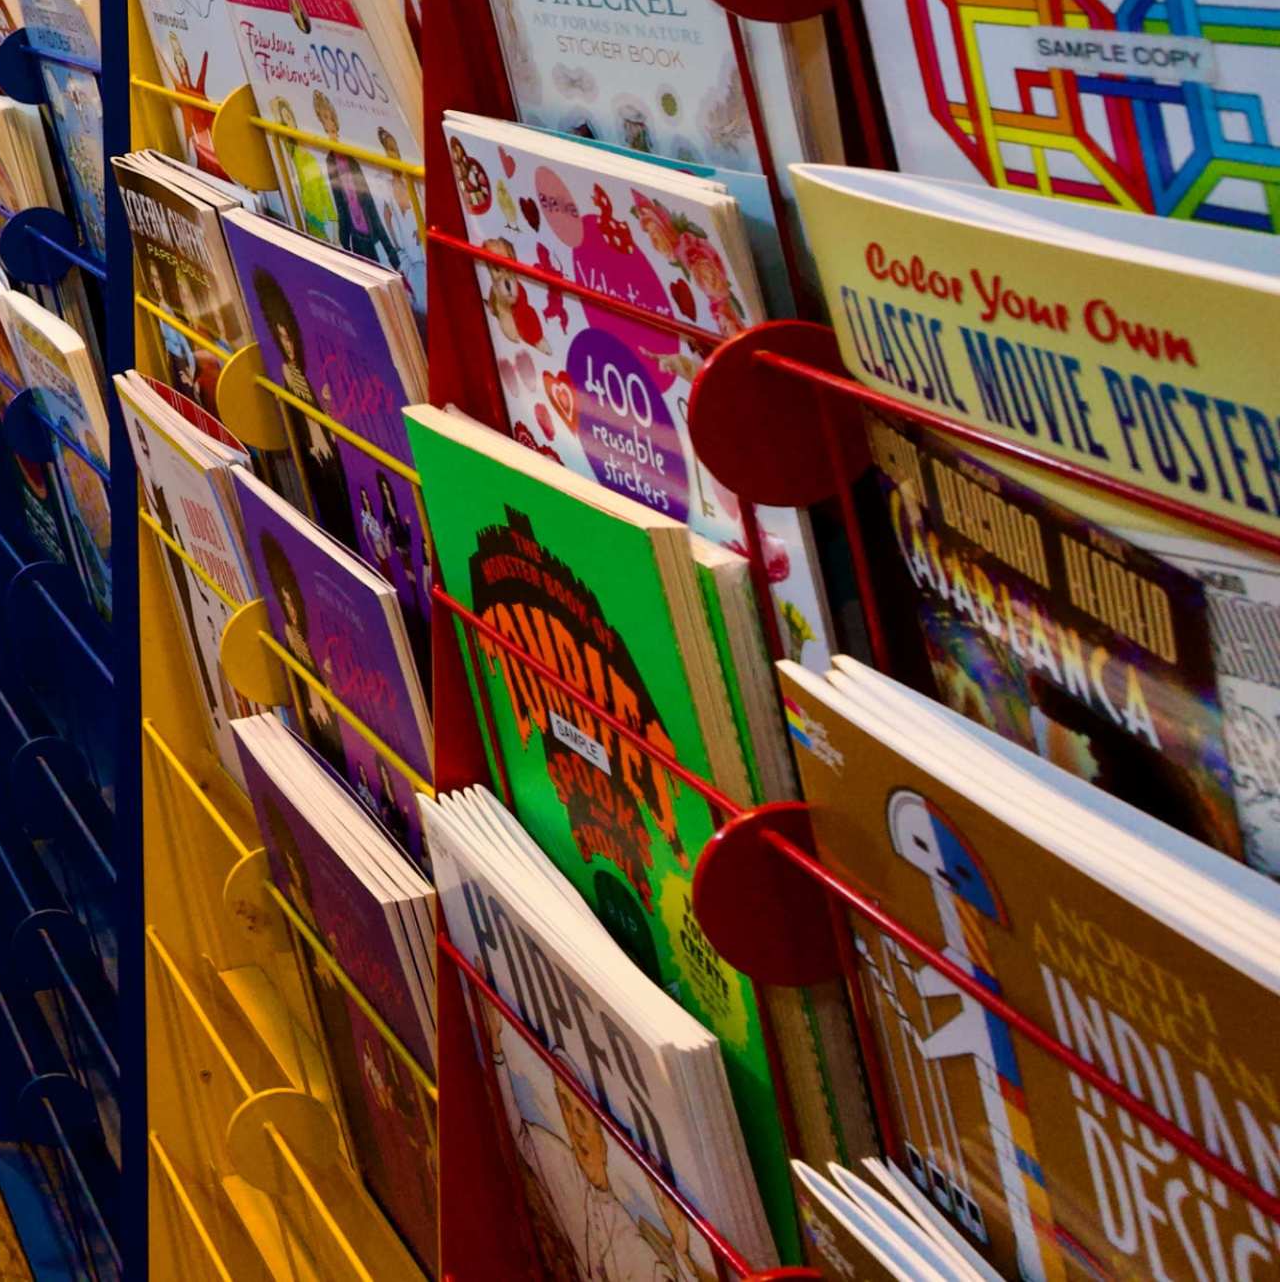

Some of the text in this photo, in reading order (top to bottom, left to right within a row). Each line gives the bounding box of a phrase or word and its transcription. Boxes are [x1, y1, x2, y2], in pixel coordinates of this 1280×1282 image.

[554, 35, 685, 70] STICKER BOOK
[563, 15, 703, 46] FORMS IN NATURE
[1037, 35, 1202, 71] SAMPLE COPY
[309, 42, 391, 105] 1980s
[864, 240, 1199, 370] Color Your Own
[585, 355, 654, 429] 400
[958, 324, 1112, 463] MOVIE
[592, 422, 666, 476] reusable
[602, 458, 670, 512] stickers
[555, 720, 600, 760] SAMPLE
